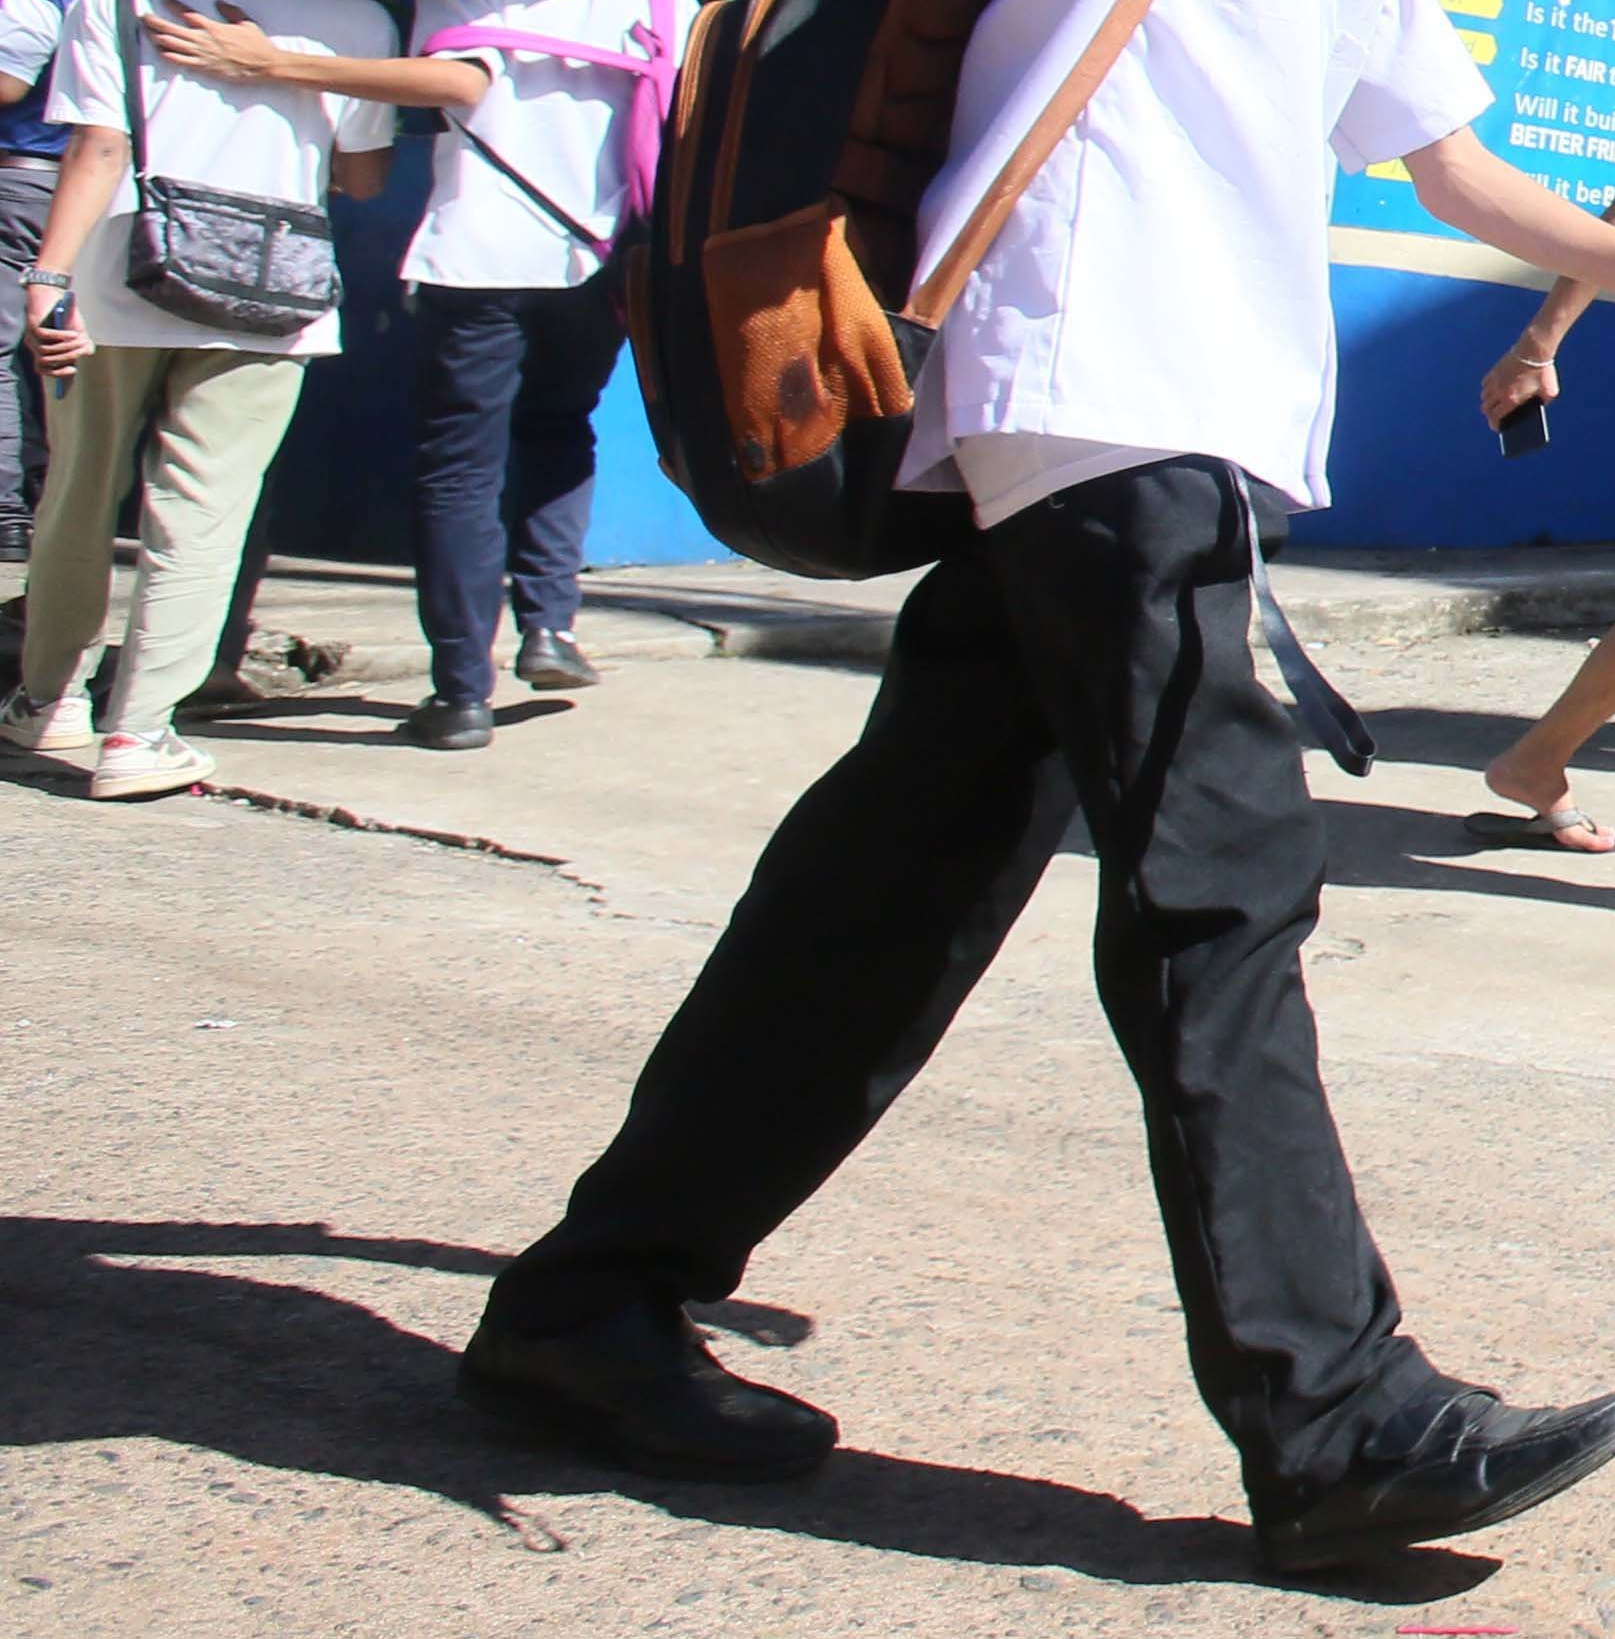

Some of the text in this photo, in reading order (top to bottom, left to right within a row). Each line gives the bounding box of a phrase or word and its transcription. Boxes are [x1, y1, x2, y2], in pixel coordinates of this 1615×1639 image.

[1526, 1, 1545, 24] Is
[1551, 7, 1567, 29] it
[1573, 12, 1608, 38] the
[1520, 47, 1538, 70] Is
[1545, 52, 1560, 75] it
[1565, 55, 1605, 84] FAIR
[1515, 93, 1558, 121] Will
[1563, 102, 1579, 124] it
[1510, 122, 1584, 157] BETTER
[1576, 181, 1603, 205] be
